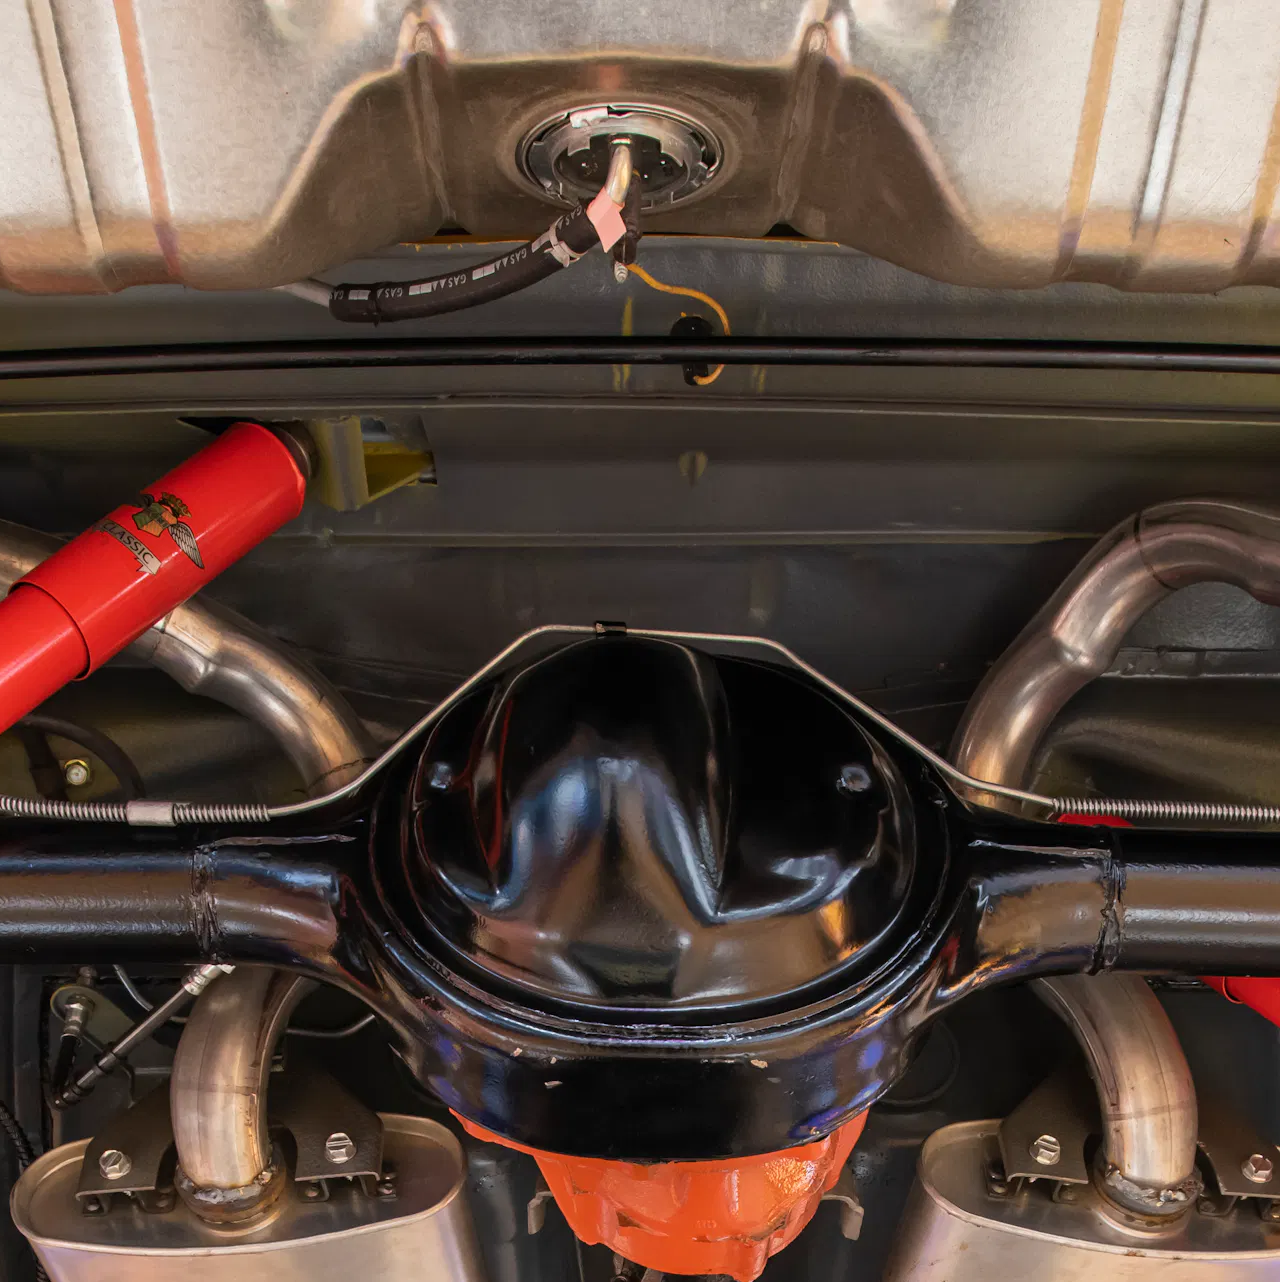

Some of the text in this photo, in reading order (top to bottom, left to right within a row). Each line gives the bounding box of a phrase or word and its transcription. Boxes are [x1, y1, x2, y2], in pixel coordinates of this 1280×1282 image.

[565, 203, 583, 226] GAS
[510, 249, 528, 265] GAS
[447, 274, 467, 289] GAS
[384, 286, 404, 298] GAS
[102, 520, 155, 565] CLASSIC
